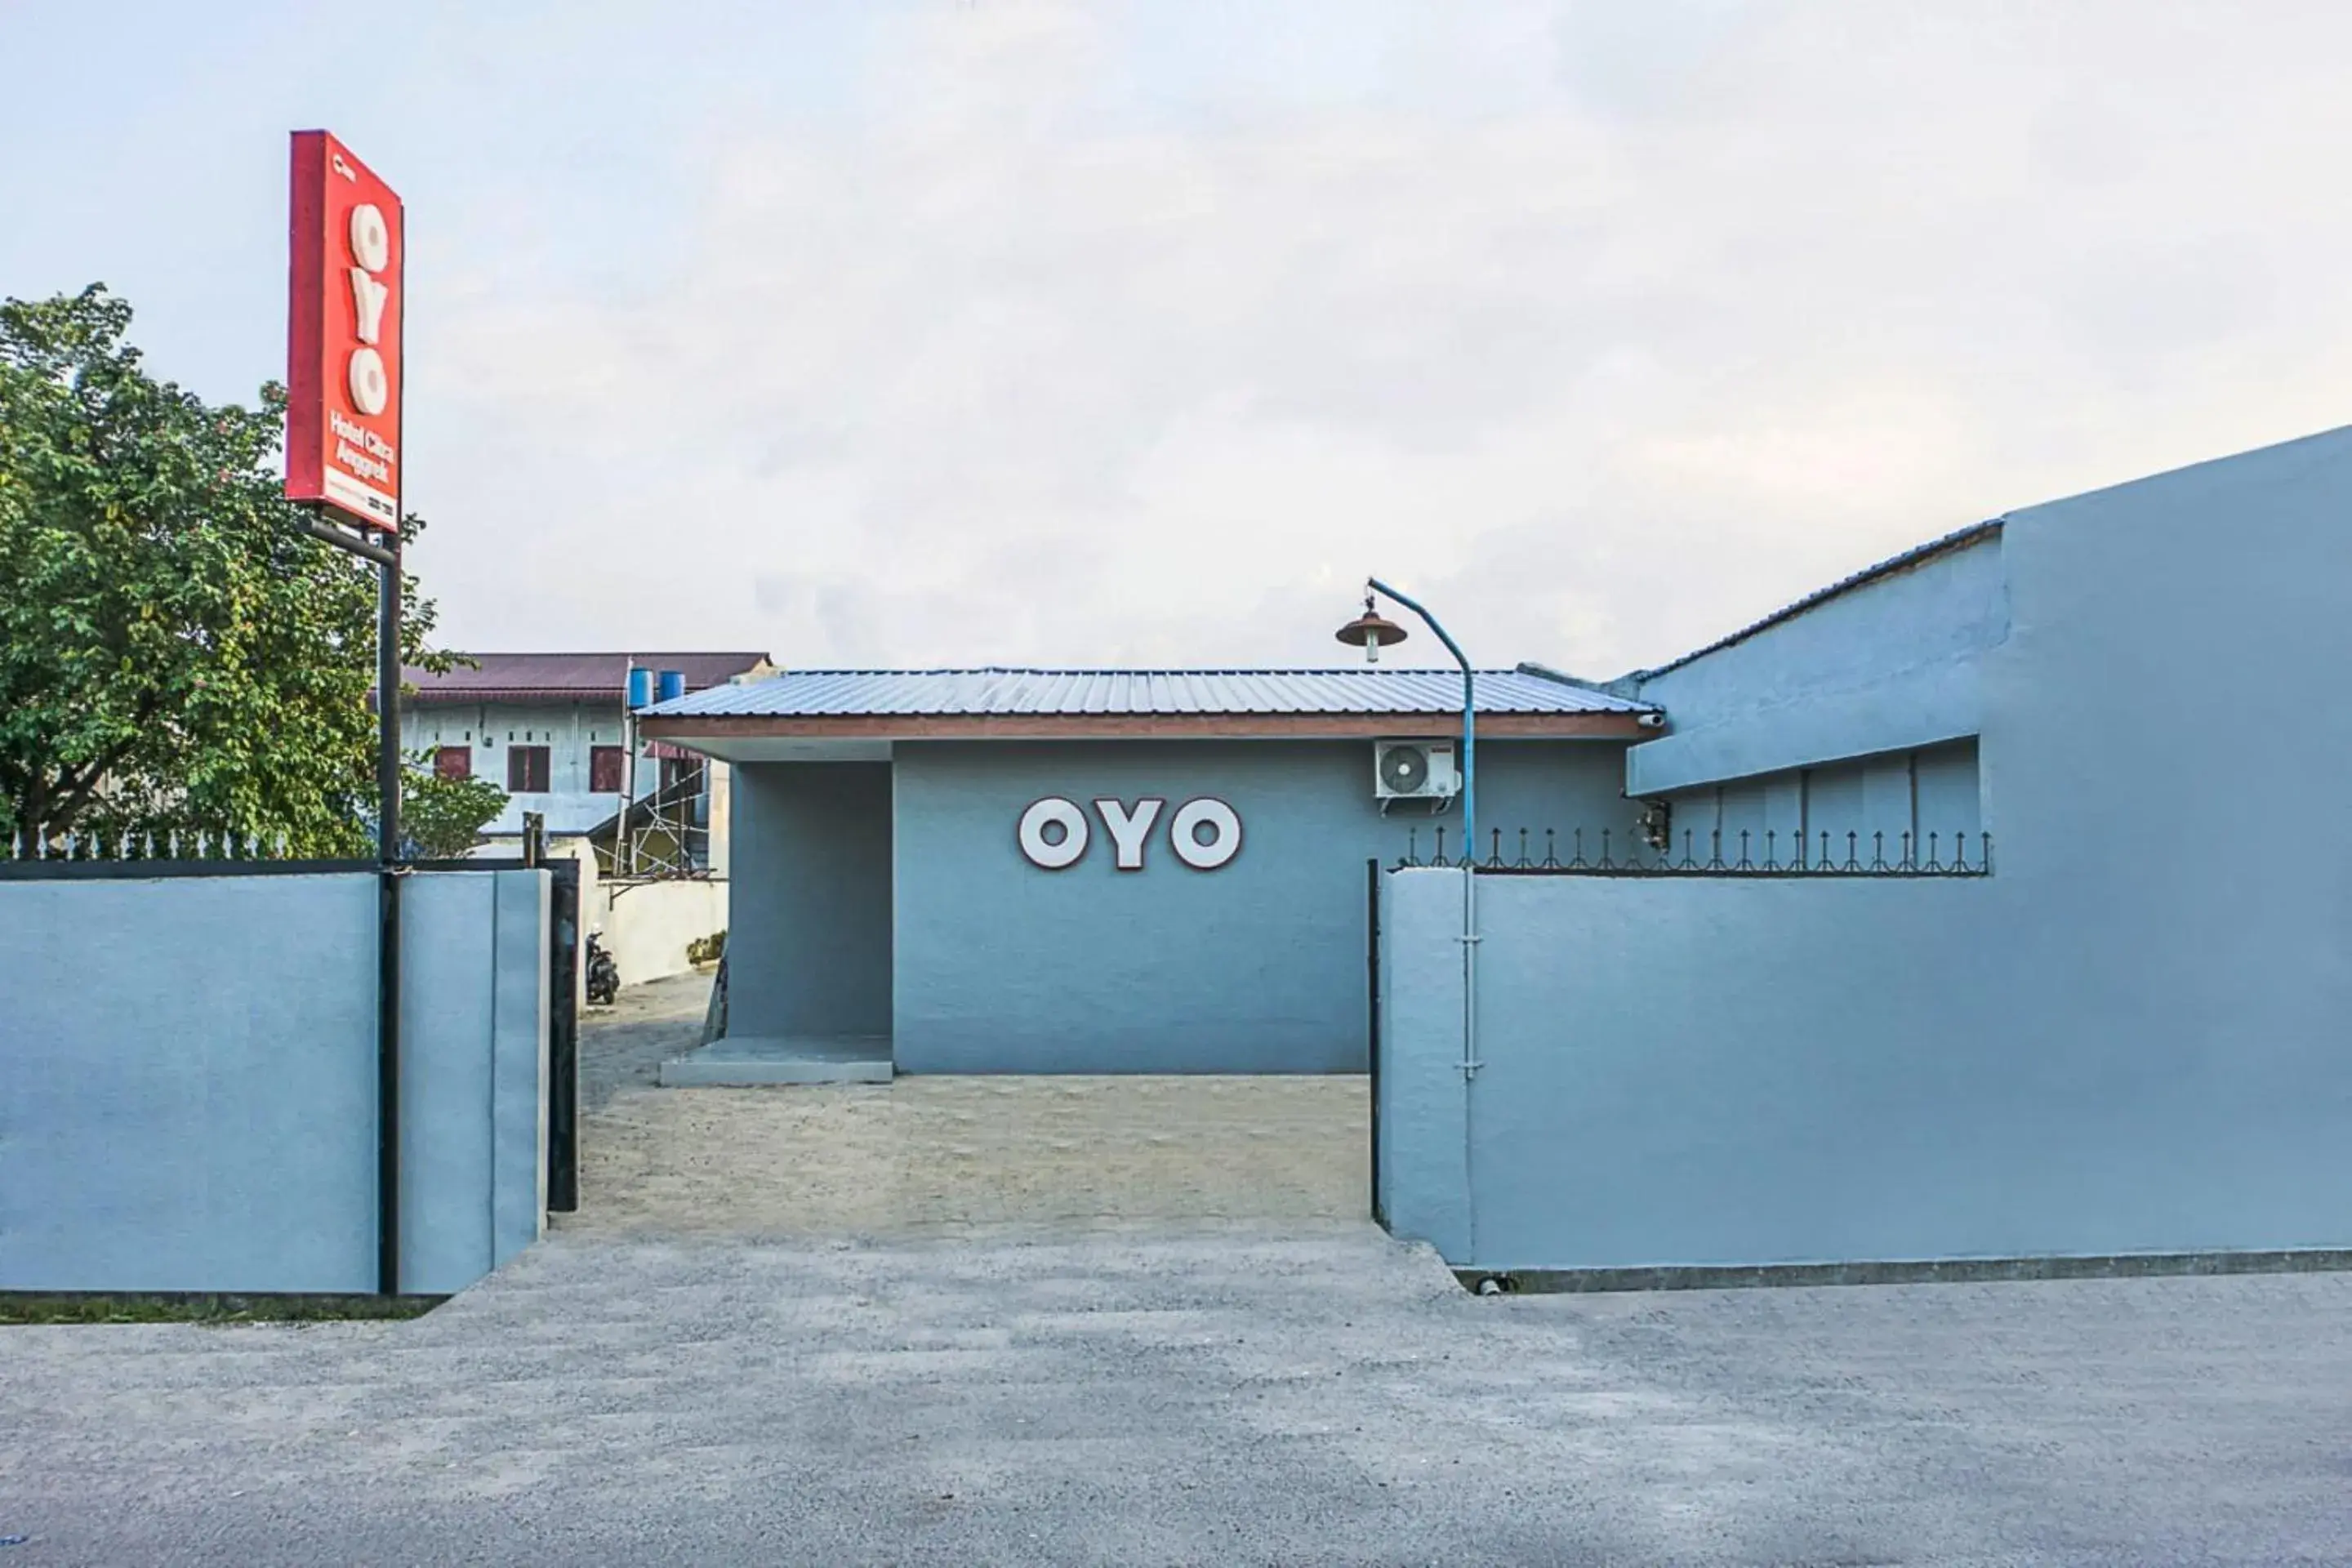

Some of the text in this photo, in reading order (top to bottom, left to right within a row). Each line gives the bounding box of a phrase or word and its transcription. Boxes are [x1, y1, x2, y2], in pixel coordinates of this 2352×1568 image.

[350, 203, 388, 416] OYO
[330, 410, 365, 448] Hotel
[1018, 797, 1242, 870] OYO
